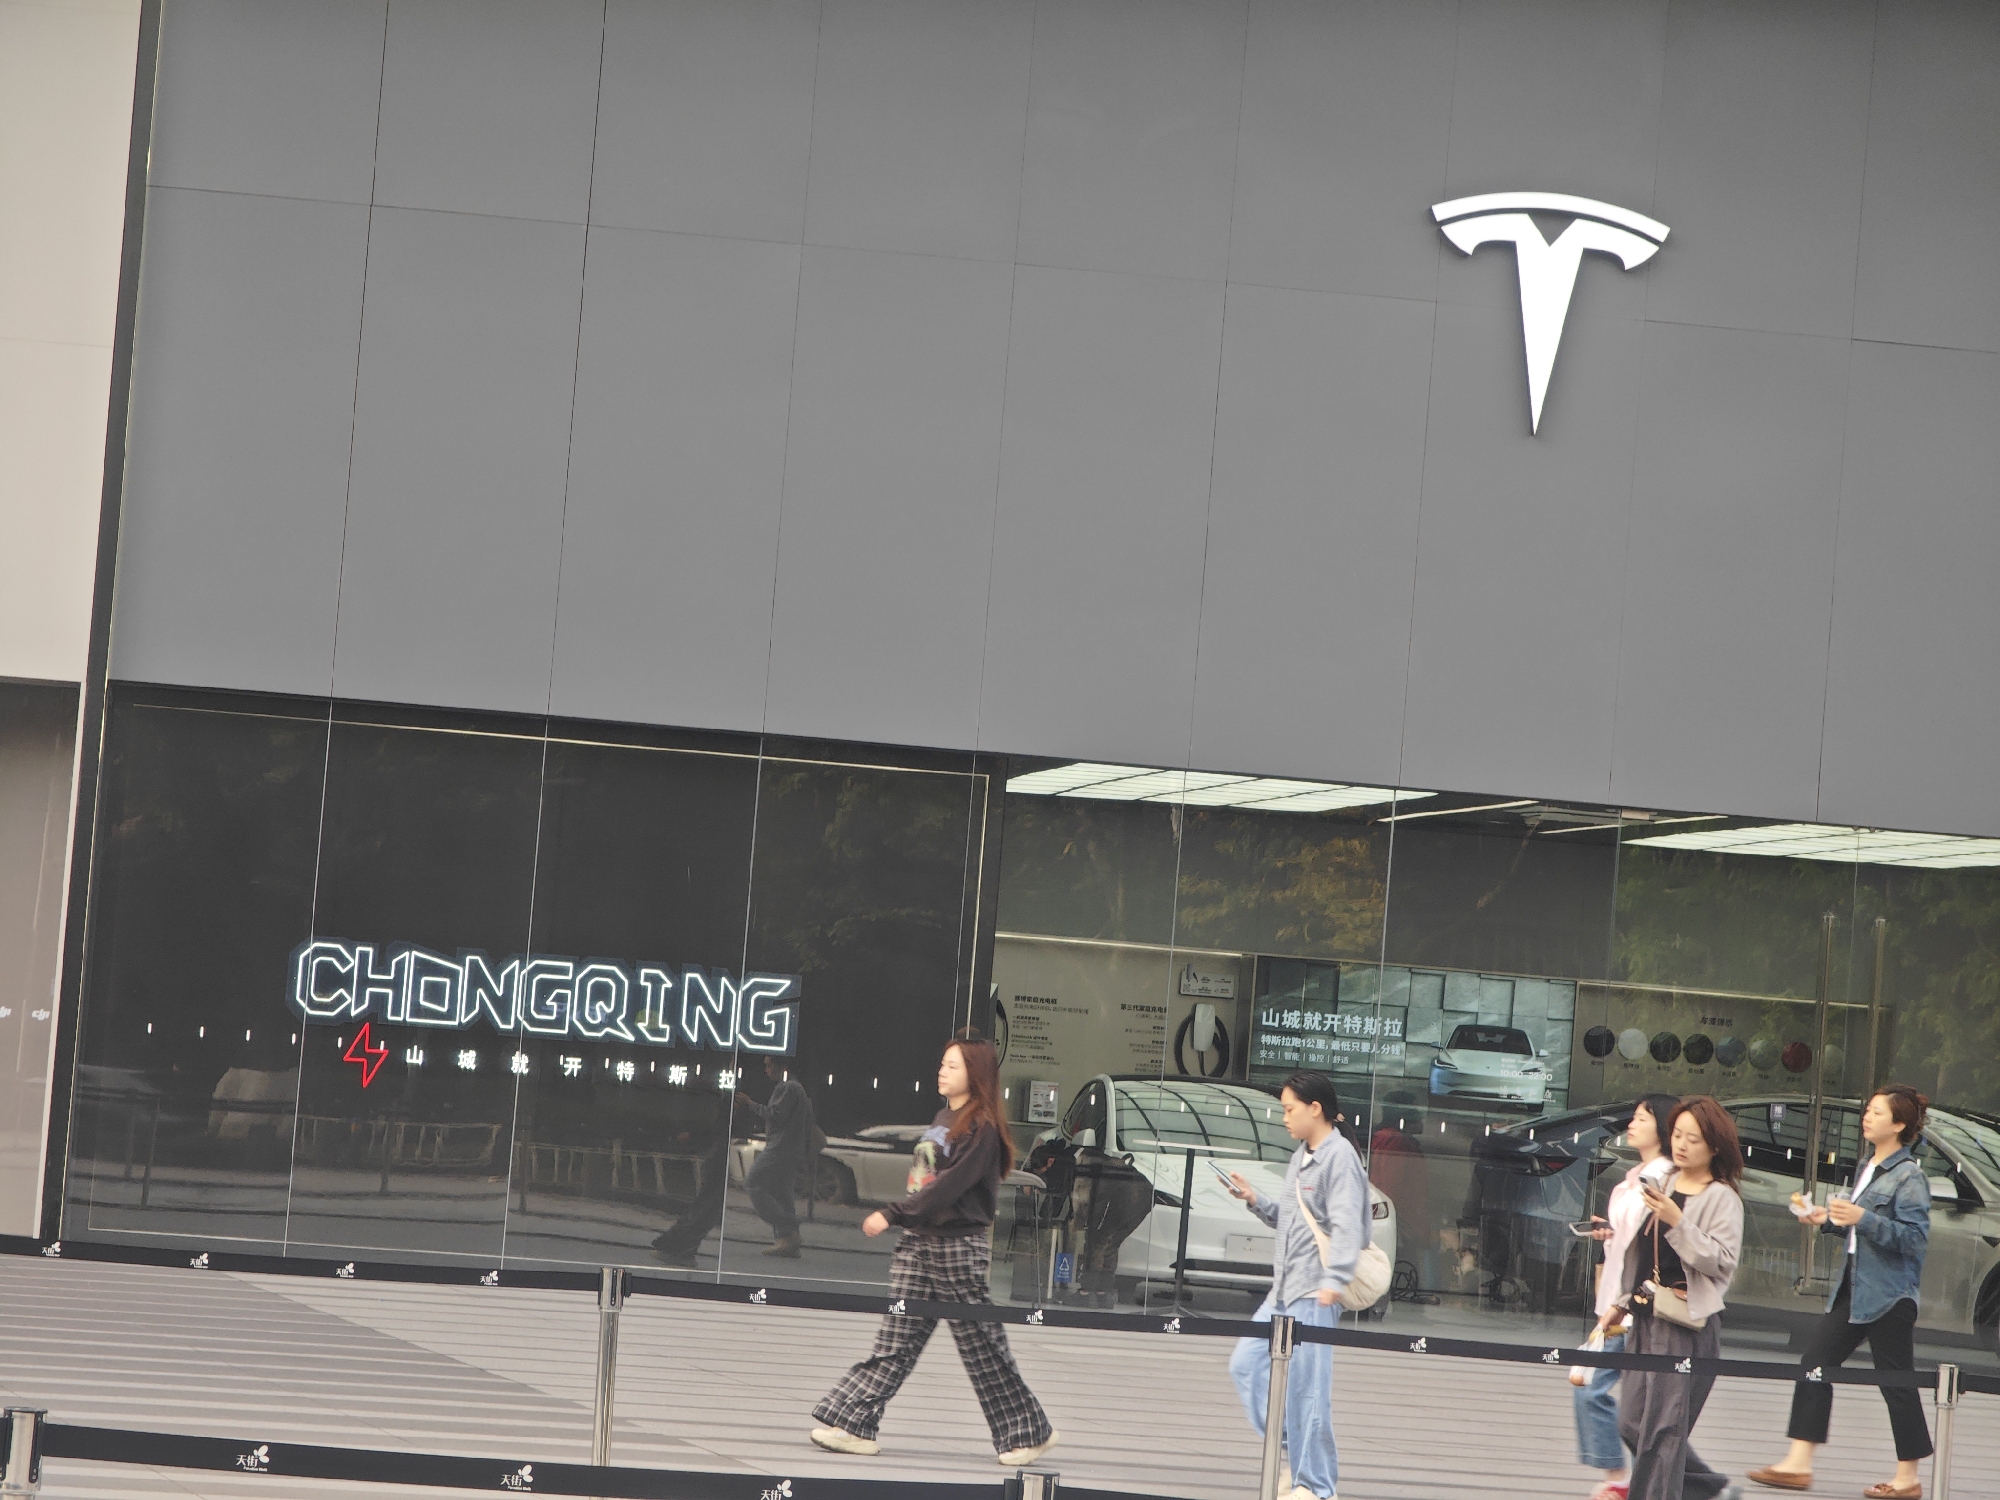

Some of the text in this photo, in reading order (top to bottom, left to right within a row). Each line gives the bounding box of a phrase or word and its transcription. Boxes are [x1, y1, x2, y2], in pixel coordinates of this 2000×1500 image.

[295, 941, 793, 1052] CHONGQING
[1261, 1007, 1403, 1037] 山城就开特斯拉
[1259, 1049, 1276, 1060] 安全
[1284, 1051, 1300, 1062] 智能
[405, 1044, 737, 1090] 山城就开特斯拉
[235, 1454, 259, 1468] 天街
[500, 1474, 523, 1487] 天街
[760, 1489, 783, 1500] 天街
